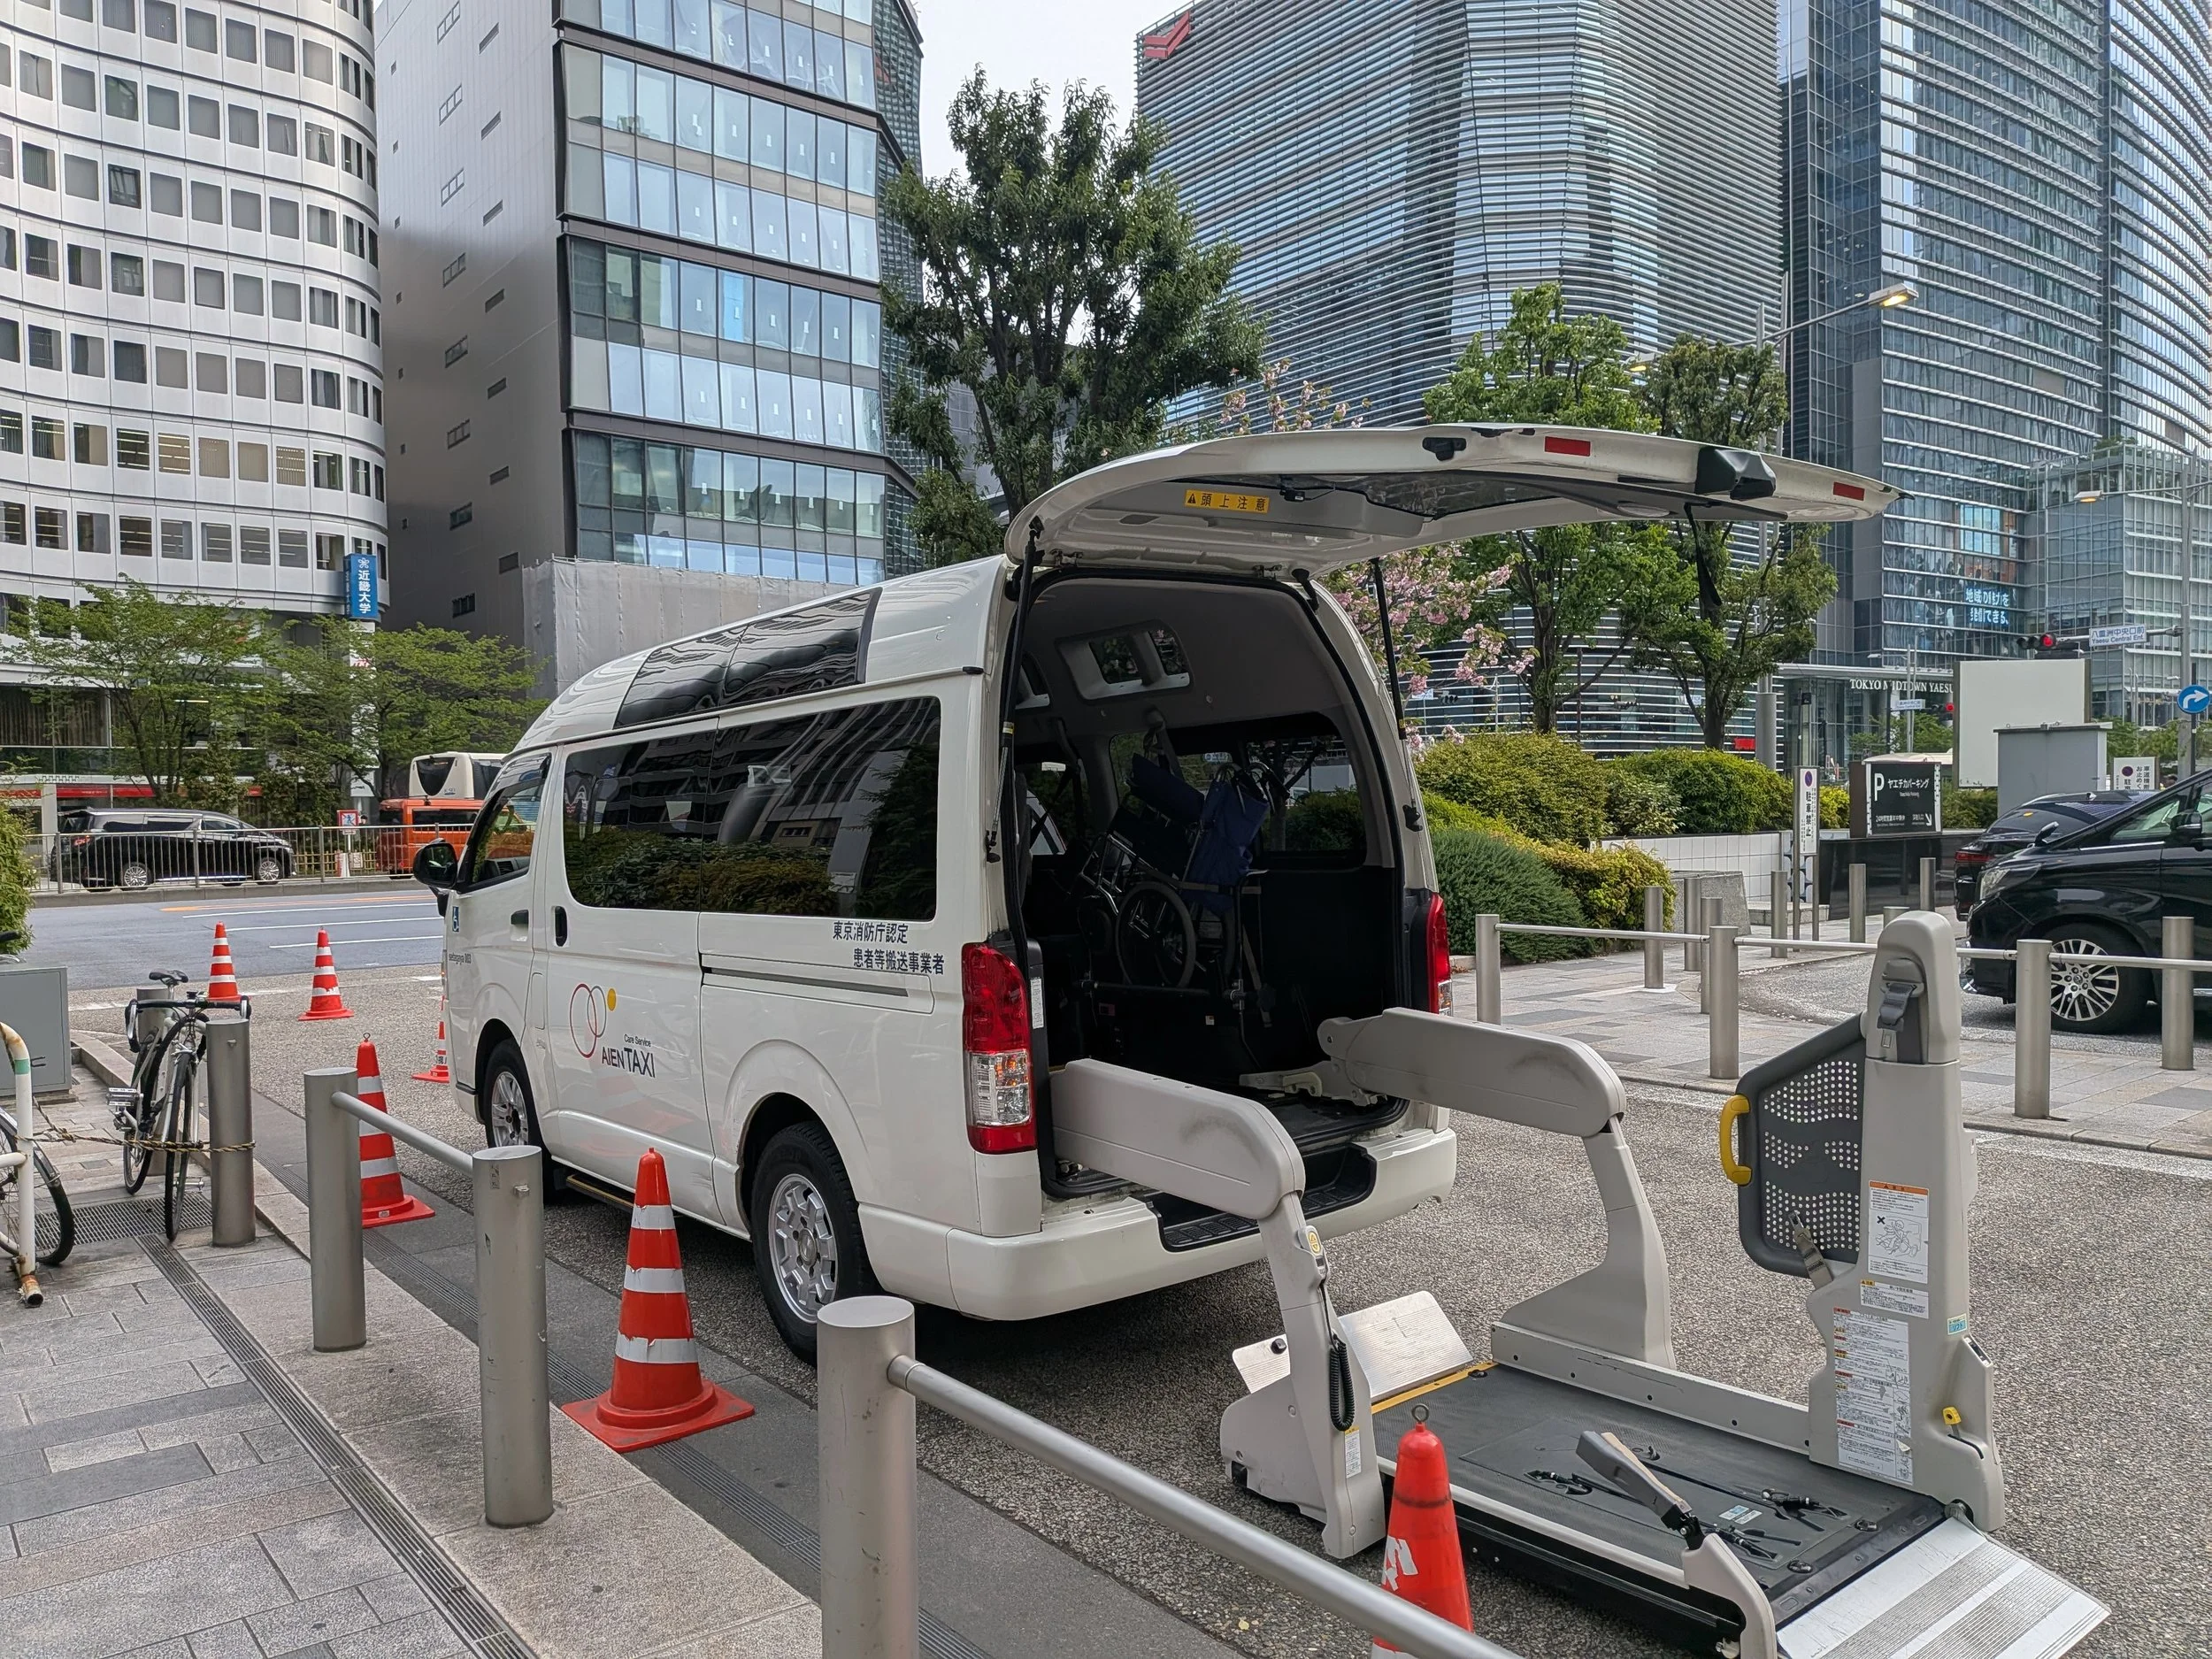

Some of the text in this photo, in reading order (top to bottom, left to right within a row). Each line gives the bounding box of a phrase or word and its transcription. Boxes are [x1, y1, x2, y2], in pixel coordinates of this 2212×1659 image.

[1201, 493, 1265, 511] 頭上注意
[358, 570, 371, 614] 近畿大学
[1850, 679, 1881, 690] TOKYO
[1875, 773, 1885, 802] P
[1888, 779, 1929, 788] ヤエチカパーキング
[833, 921, 908, 944] 東京消防庁認定
[854, 948, 944, 975] 患者等搬送事業者
[624, 1033, 651, 1048] Care Service
